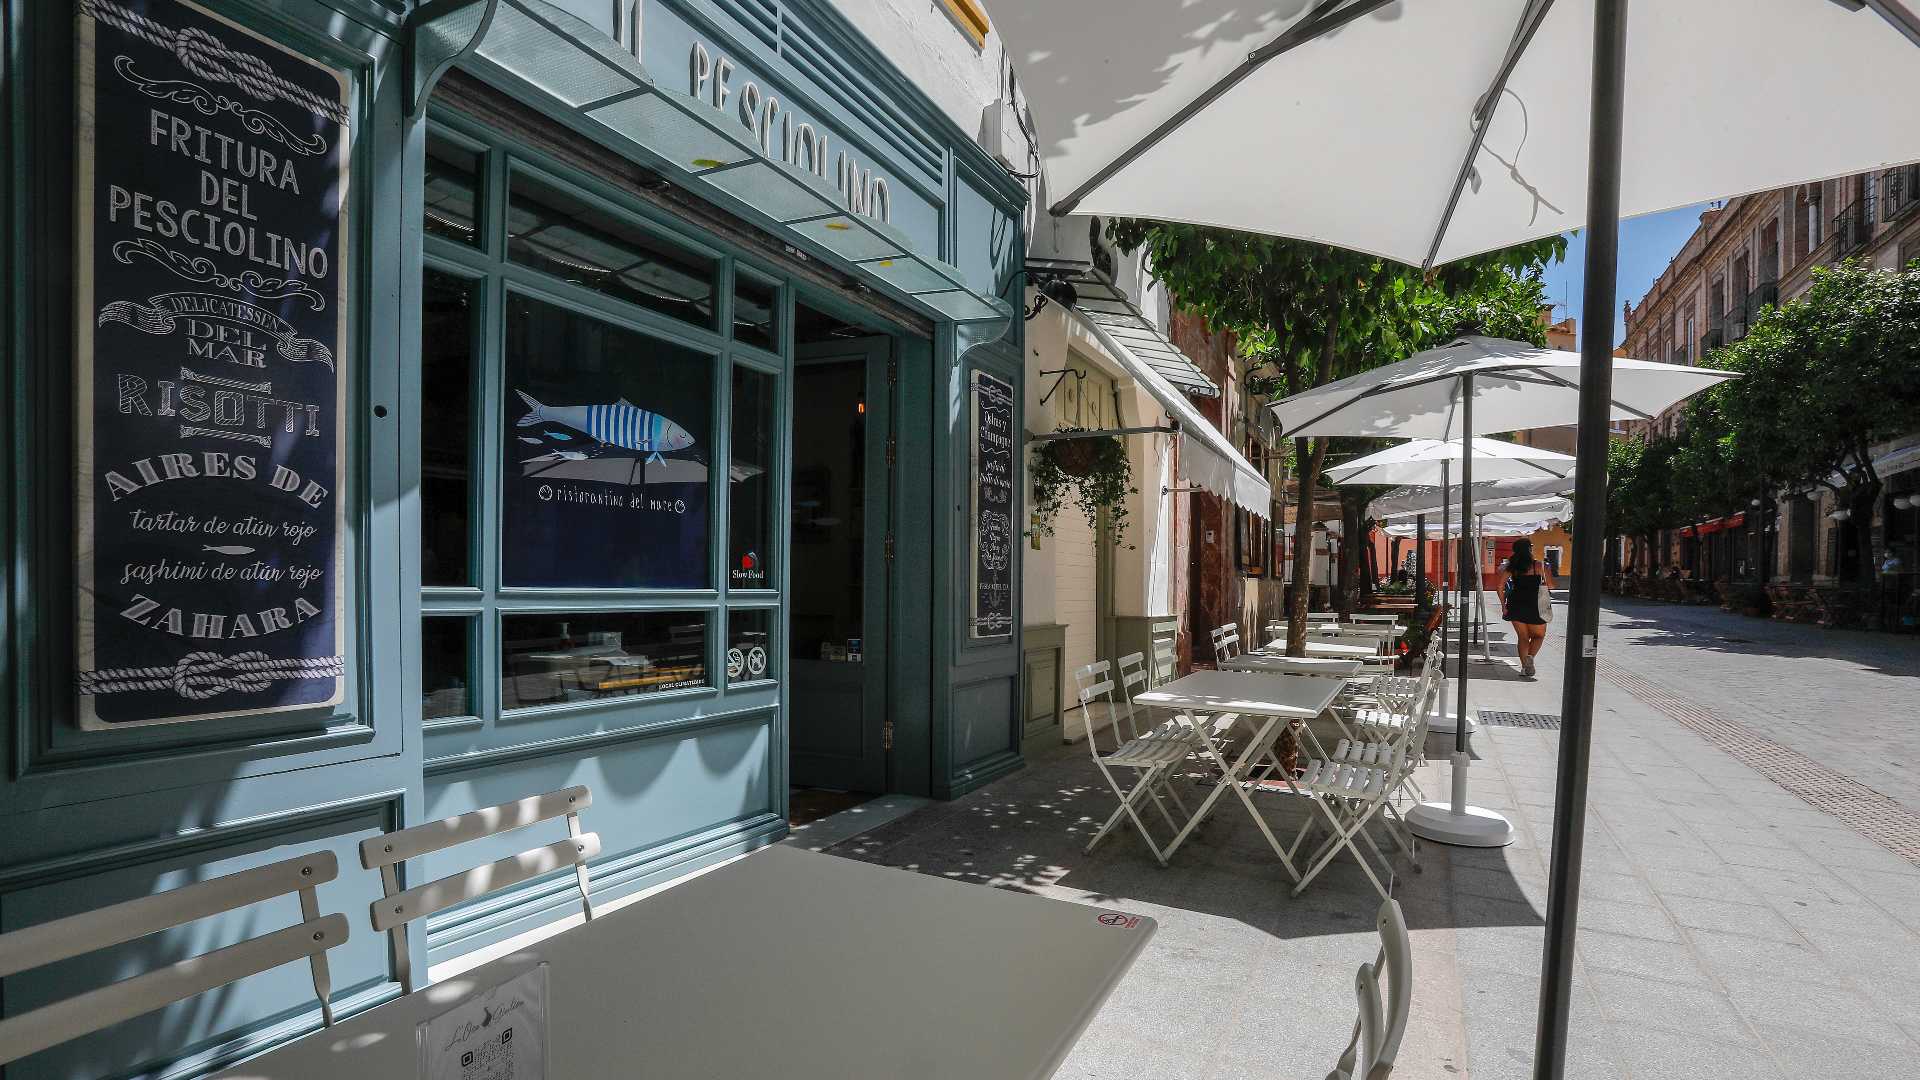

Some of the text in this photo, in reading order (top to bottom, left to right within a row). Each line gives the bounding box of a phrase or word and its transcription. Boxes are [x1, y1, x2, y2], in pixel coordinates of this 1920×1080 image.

[151, 108, 300, 195] FRITURA
[200, 170, 258, 221] DEL
[109, 184, 328, 279] PESCIOLINO
[170, 296, 283, 331] DELICATESSEN
[186, 318, 267, 351] DEL
[186, 338, 267, 368] MAR
[118, 373, 320, 437] RISOTTI
[104, 451, 329, 510] AIRES DE
[630, 491, 644, 510] del
[129, 508, 318, 545] tartar de atún rojo
[120, 558, 324, 589] sashimi de atún rojo
[732, 568, 764, 579] Slow Food
[120, 593, 322, 640] ZAHARA
